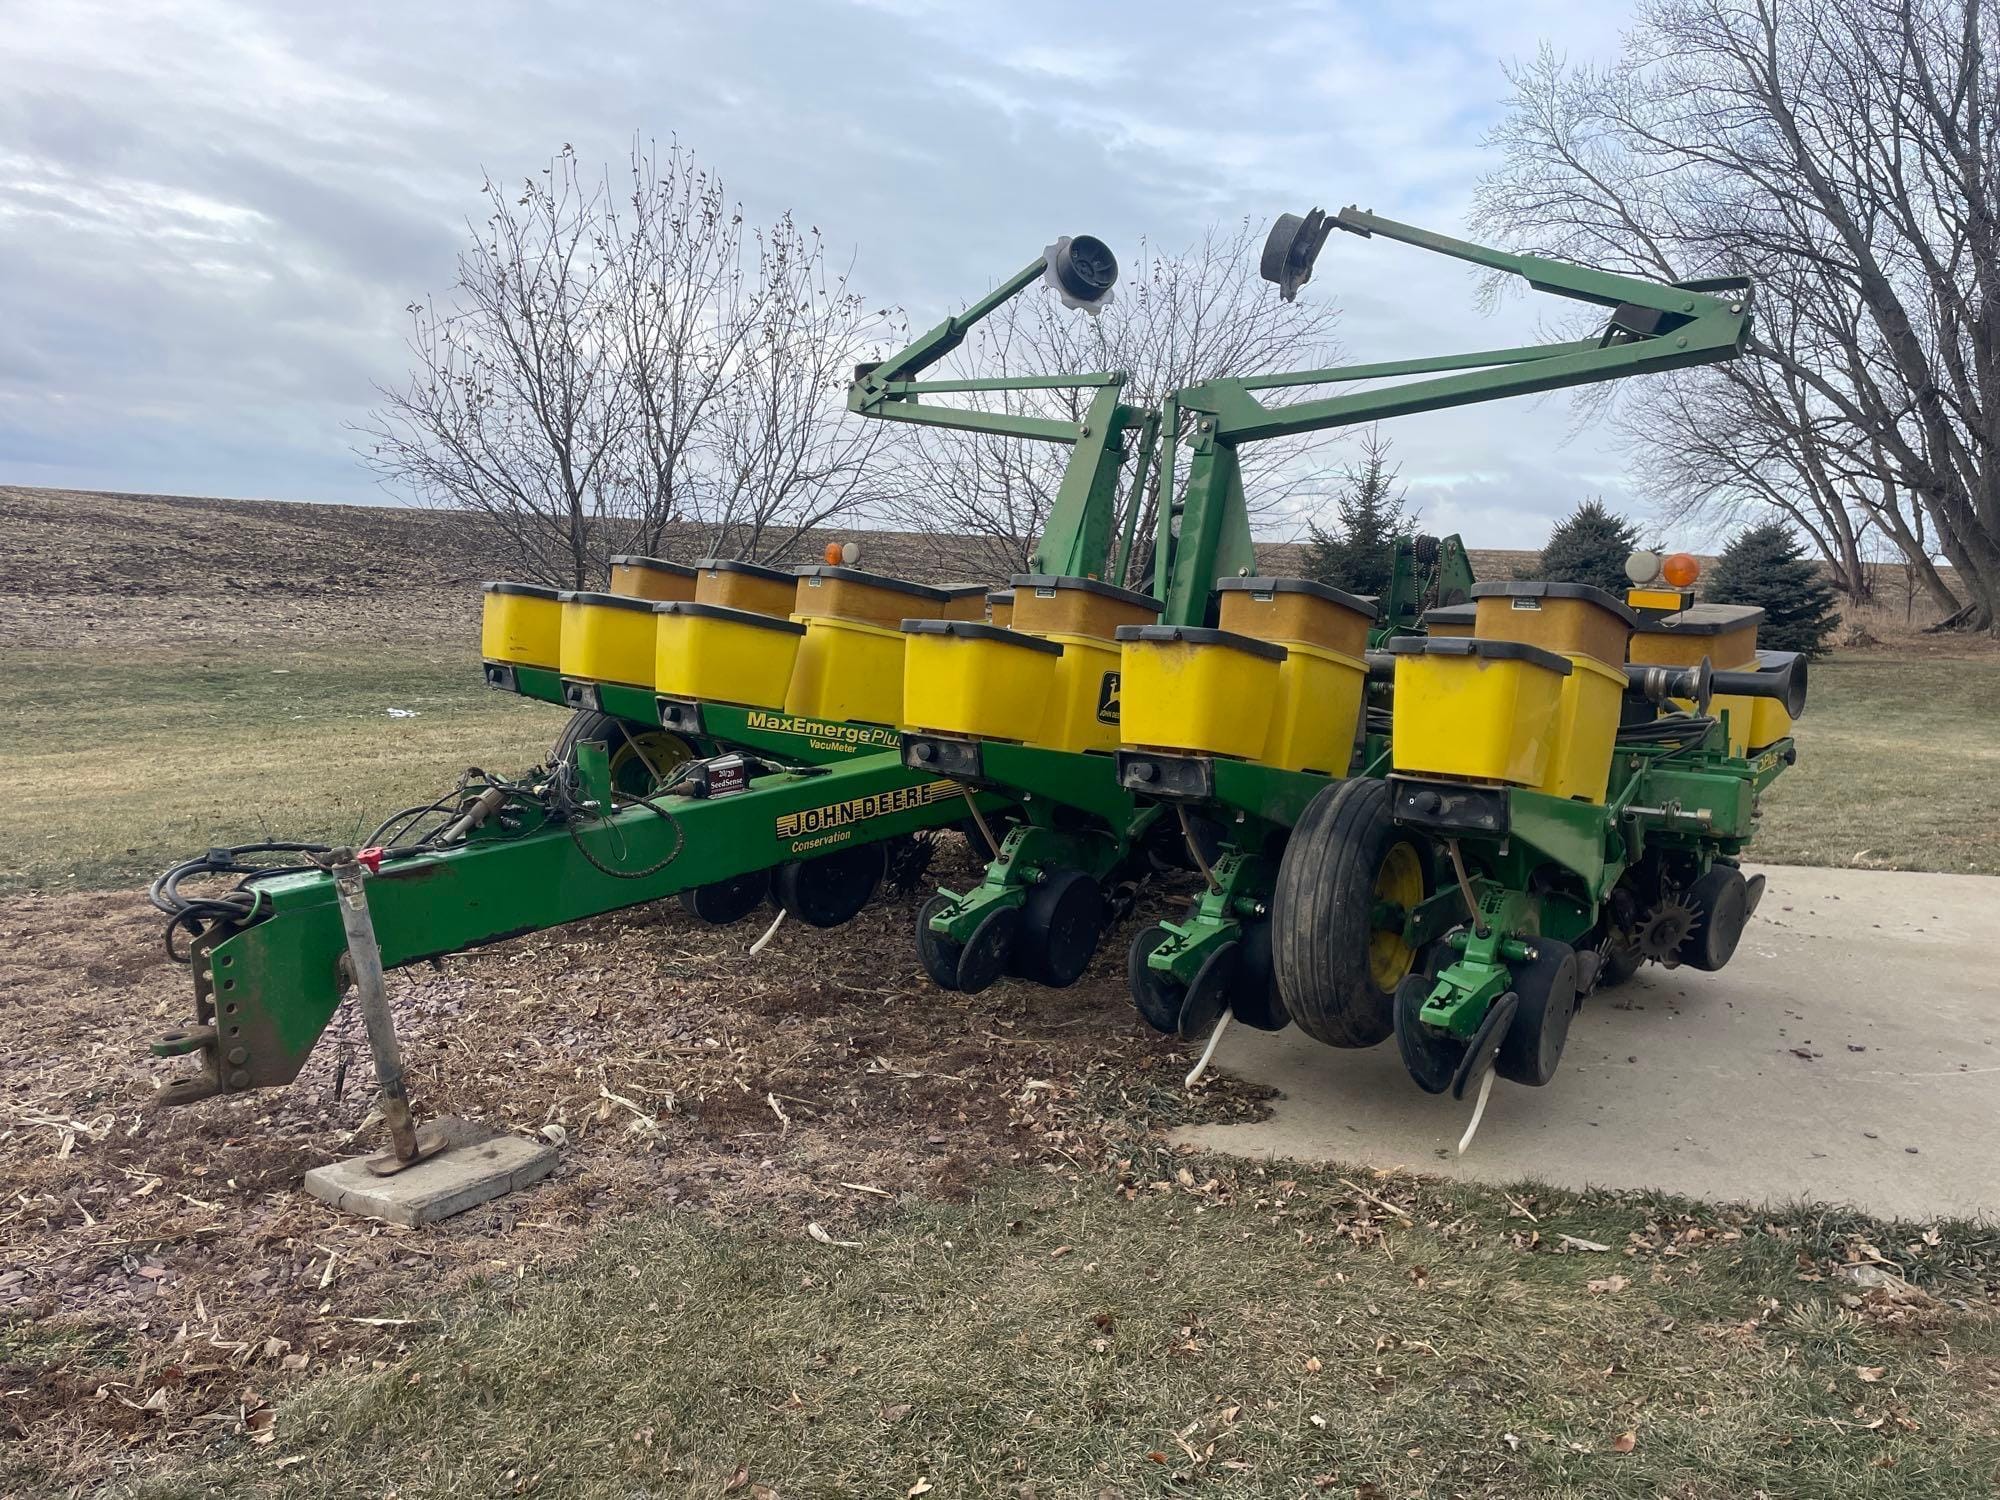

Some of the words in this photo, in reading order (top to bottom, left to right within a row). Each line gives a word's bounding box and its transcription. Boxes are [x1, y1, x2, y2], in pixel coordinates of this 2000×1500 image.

[809, 739, 857, 753] VacuMeter
[718, 770, 735, 778] 20/20
[711, 778, 743, 789] SeedSense
[787, 800, 856, 837] JOHN
[862, 784, 933, 819] DEERE
[792, 831, 851, 853] Conservation
